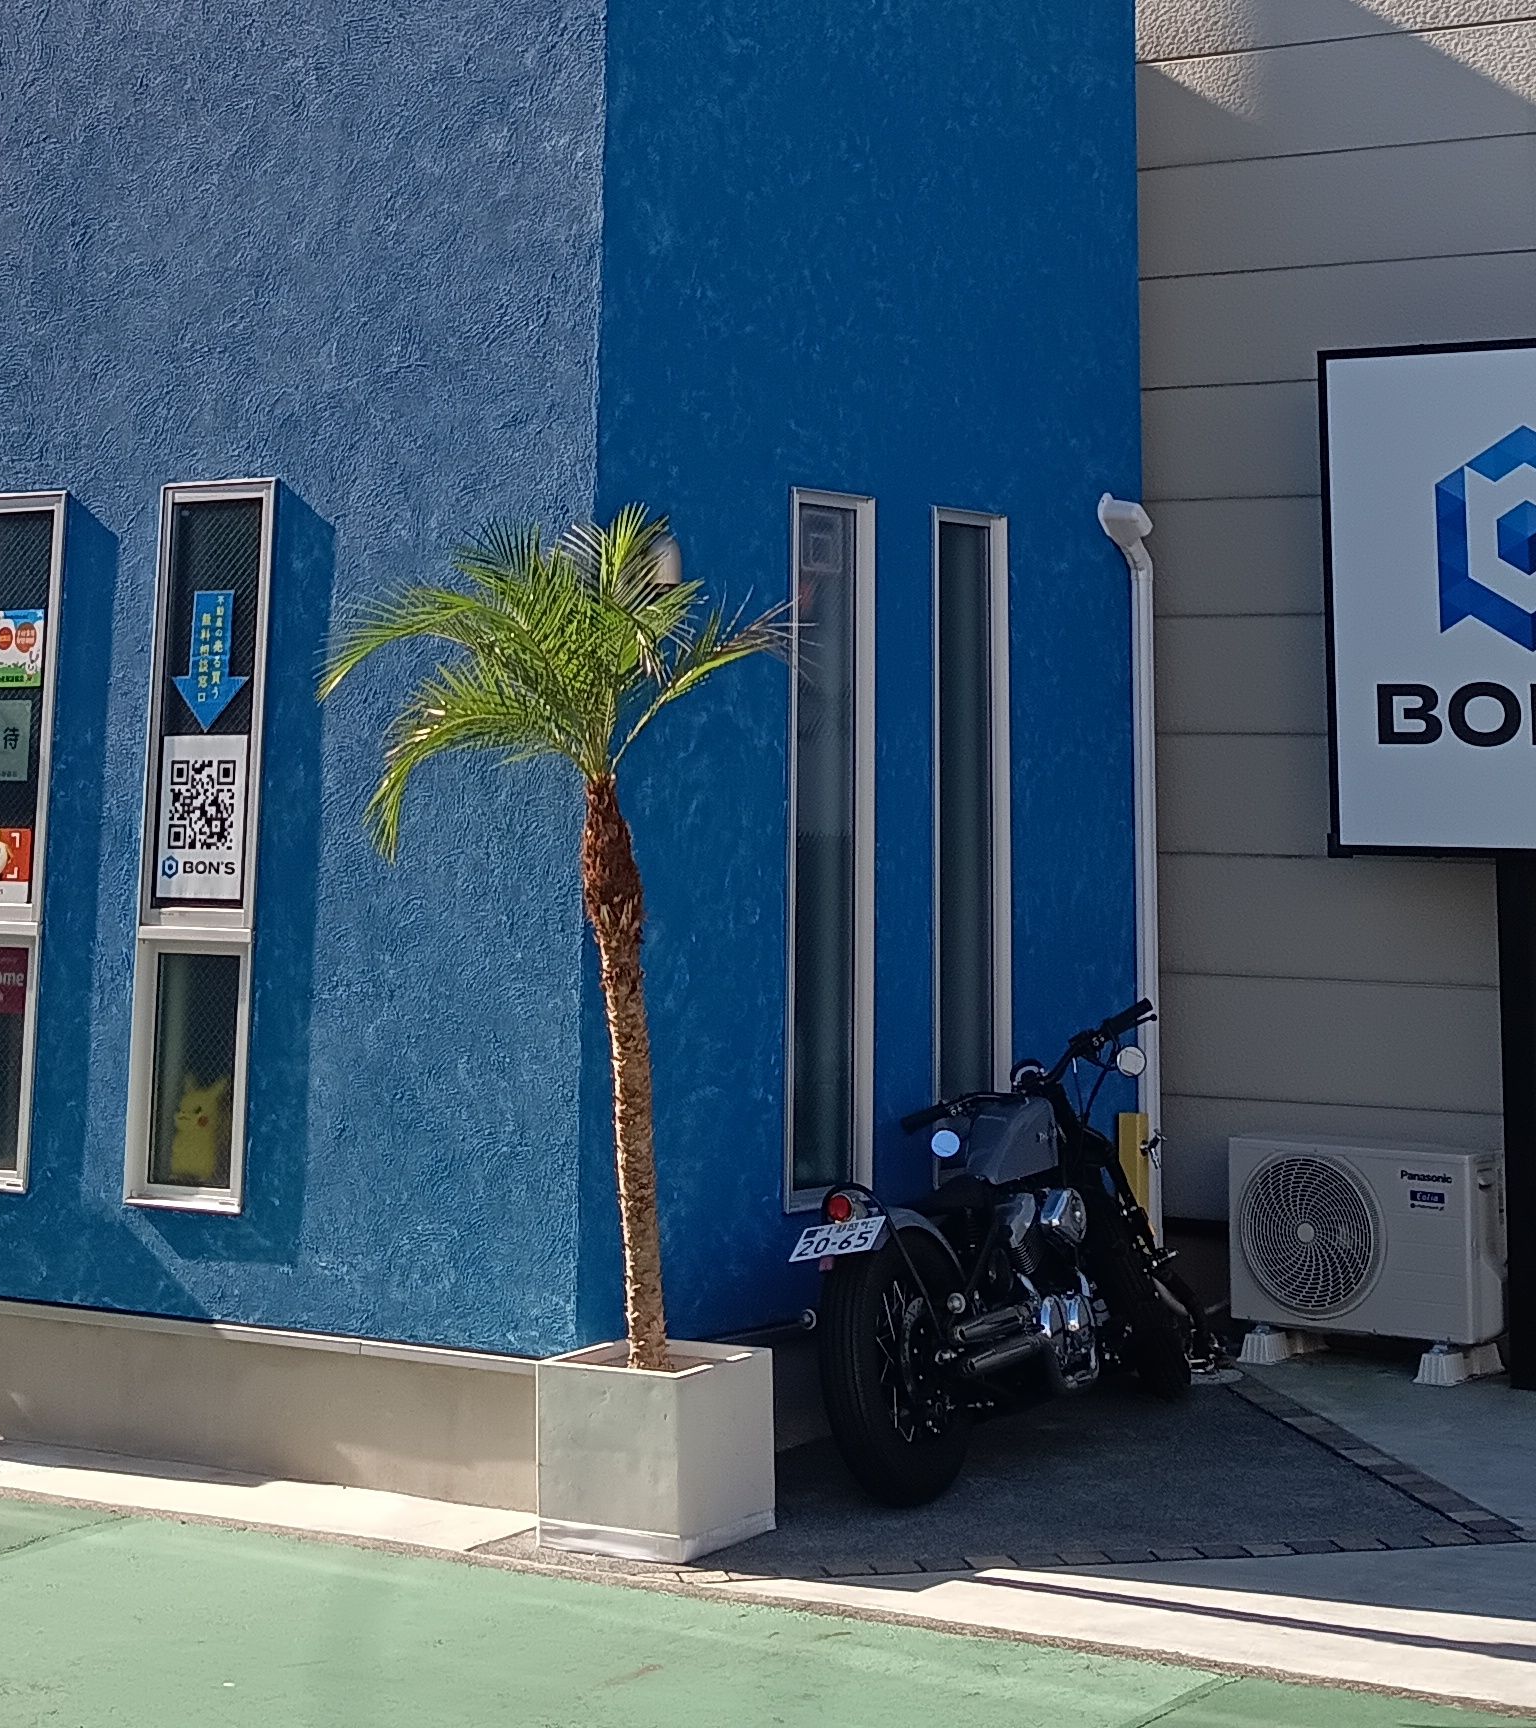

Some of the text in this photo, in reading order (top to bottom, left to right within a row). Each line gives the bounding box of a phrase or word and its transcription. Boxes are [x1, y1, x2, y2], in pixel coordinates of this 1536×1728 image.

[182, 860, 236, 876] BON'S
[1400, 1169, 1453, 1184] Panasonic
[795, 1230, 873, 1257] 20-65
